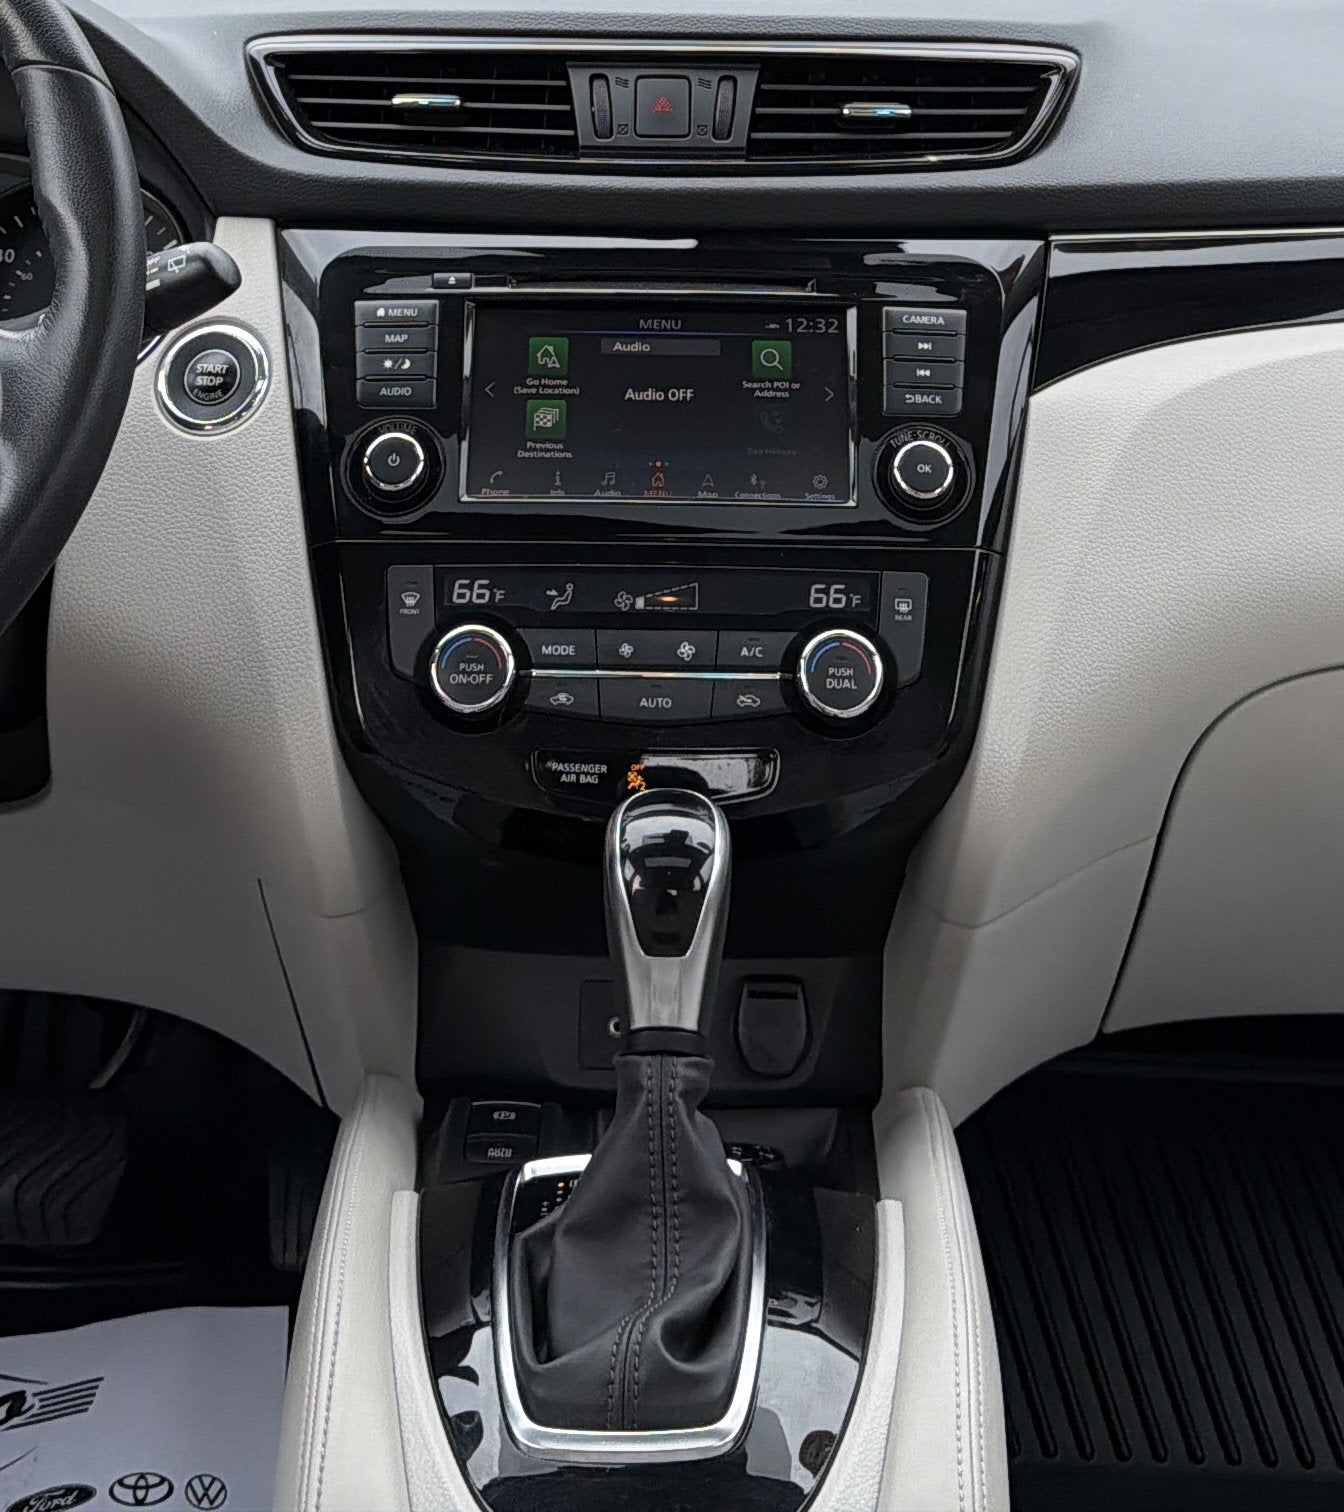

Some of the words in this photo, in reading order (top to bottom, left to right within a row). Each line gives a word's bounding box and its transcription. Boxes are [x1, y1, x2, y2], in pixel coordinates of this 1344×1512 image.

[388, 308, 419, 317] MENU
[638, 318, 683, 330] MENU
[785, 317, 840, 334] 12:32
[902, 314, 945, 326] CAMERA
[384, 333, 409, 343] MAP
[612, 341, 652, 352] Audio
[195, 362, 229, 374] START
[195, 374, 225, 387] STOP
[541, 377, 569, 386] Home
[741, 380, 772, 389] Search
[191, 388, 225, 402] ENGINE
[379, 386, 413, 396] AUDIO
[539, 386, 580, 396] Location)
[624, 387, 665, 401] Audio
[667, 388, 695, 402] OFF
[753, 389, 790, 398] Address
[915, 393, 943, 404] BACK
[526, 441, 564, 450] Previous
[516, 449, 574, 459] Destinations
[916, 463, 933, 474] OK
[481, 488, 510, 497] Phone
[594, 489, 622, 497] Audio
[541, 645, 577, 656] MODE
[739, 646, 764, 658] A/C
[459, 662, 485, 672] PUSH
[828, 667, 854, 677] PUSH
[825, 678, 858, 690] DUAL
[639, 697, 673, 709] AUTO
[551, 761, 608, 774] PASSENGER
[559, 773, 577, 784] AIR
[579, 774, 599, 785] BAG
